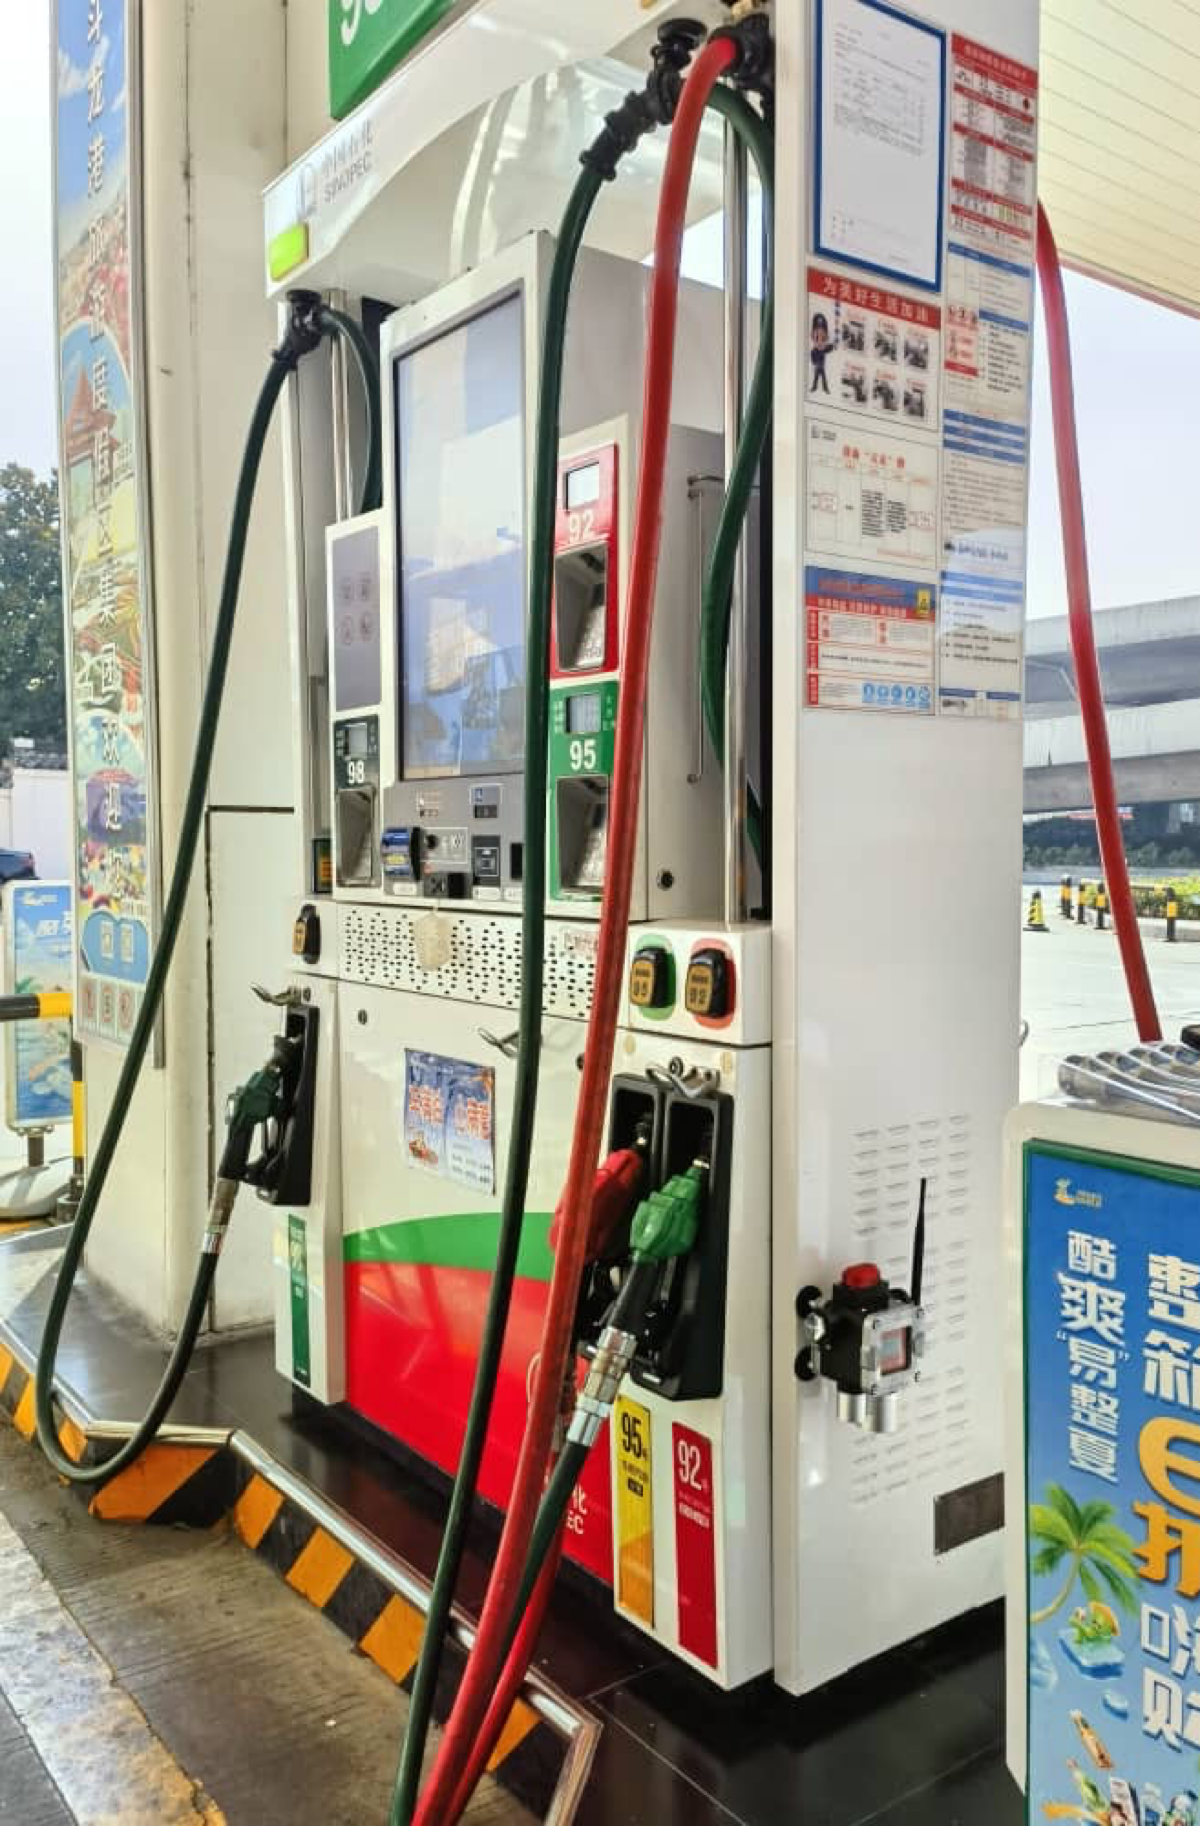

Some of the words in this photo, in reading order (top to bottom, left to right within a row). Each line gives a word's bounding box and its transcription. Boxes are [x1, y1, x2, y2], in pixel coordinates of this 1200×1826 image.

[569, 509, 595, 543] 92
[569, 738, 597, 771] 95
[348, 760, 365, 784] 98
[622, 1411, 642, 1458] 95
[678, 1439, 702, 1491] 92
